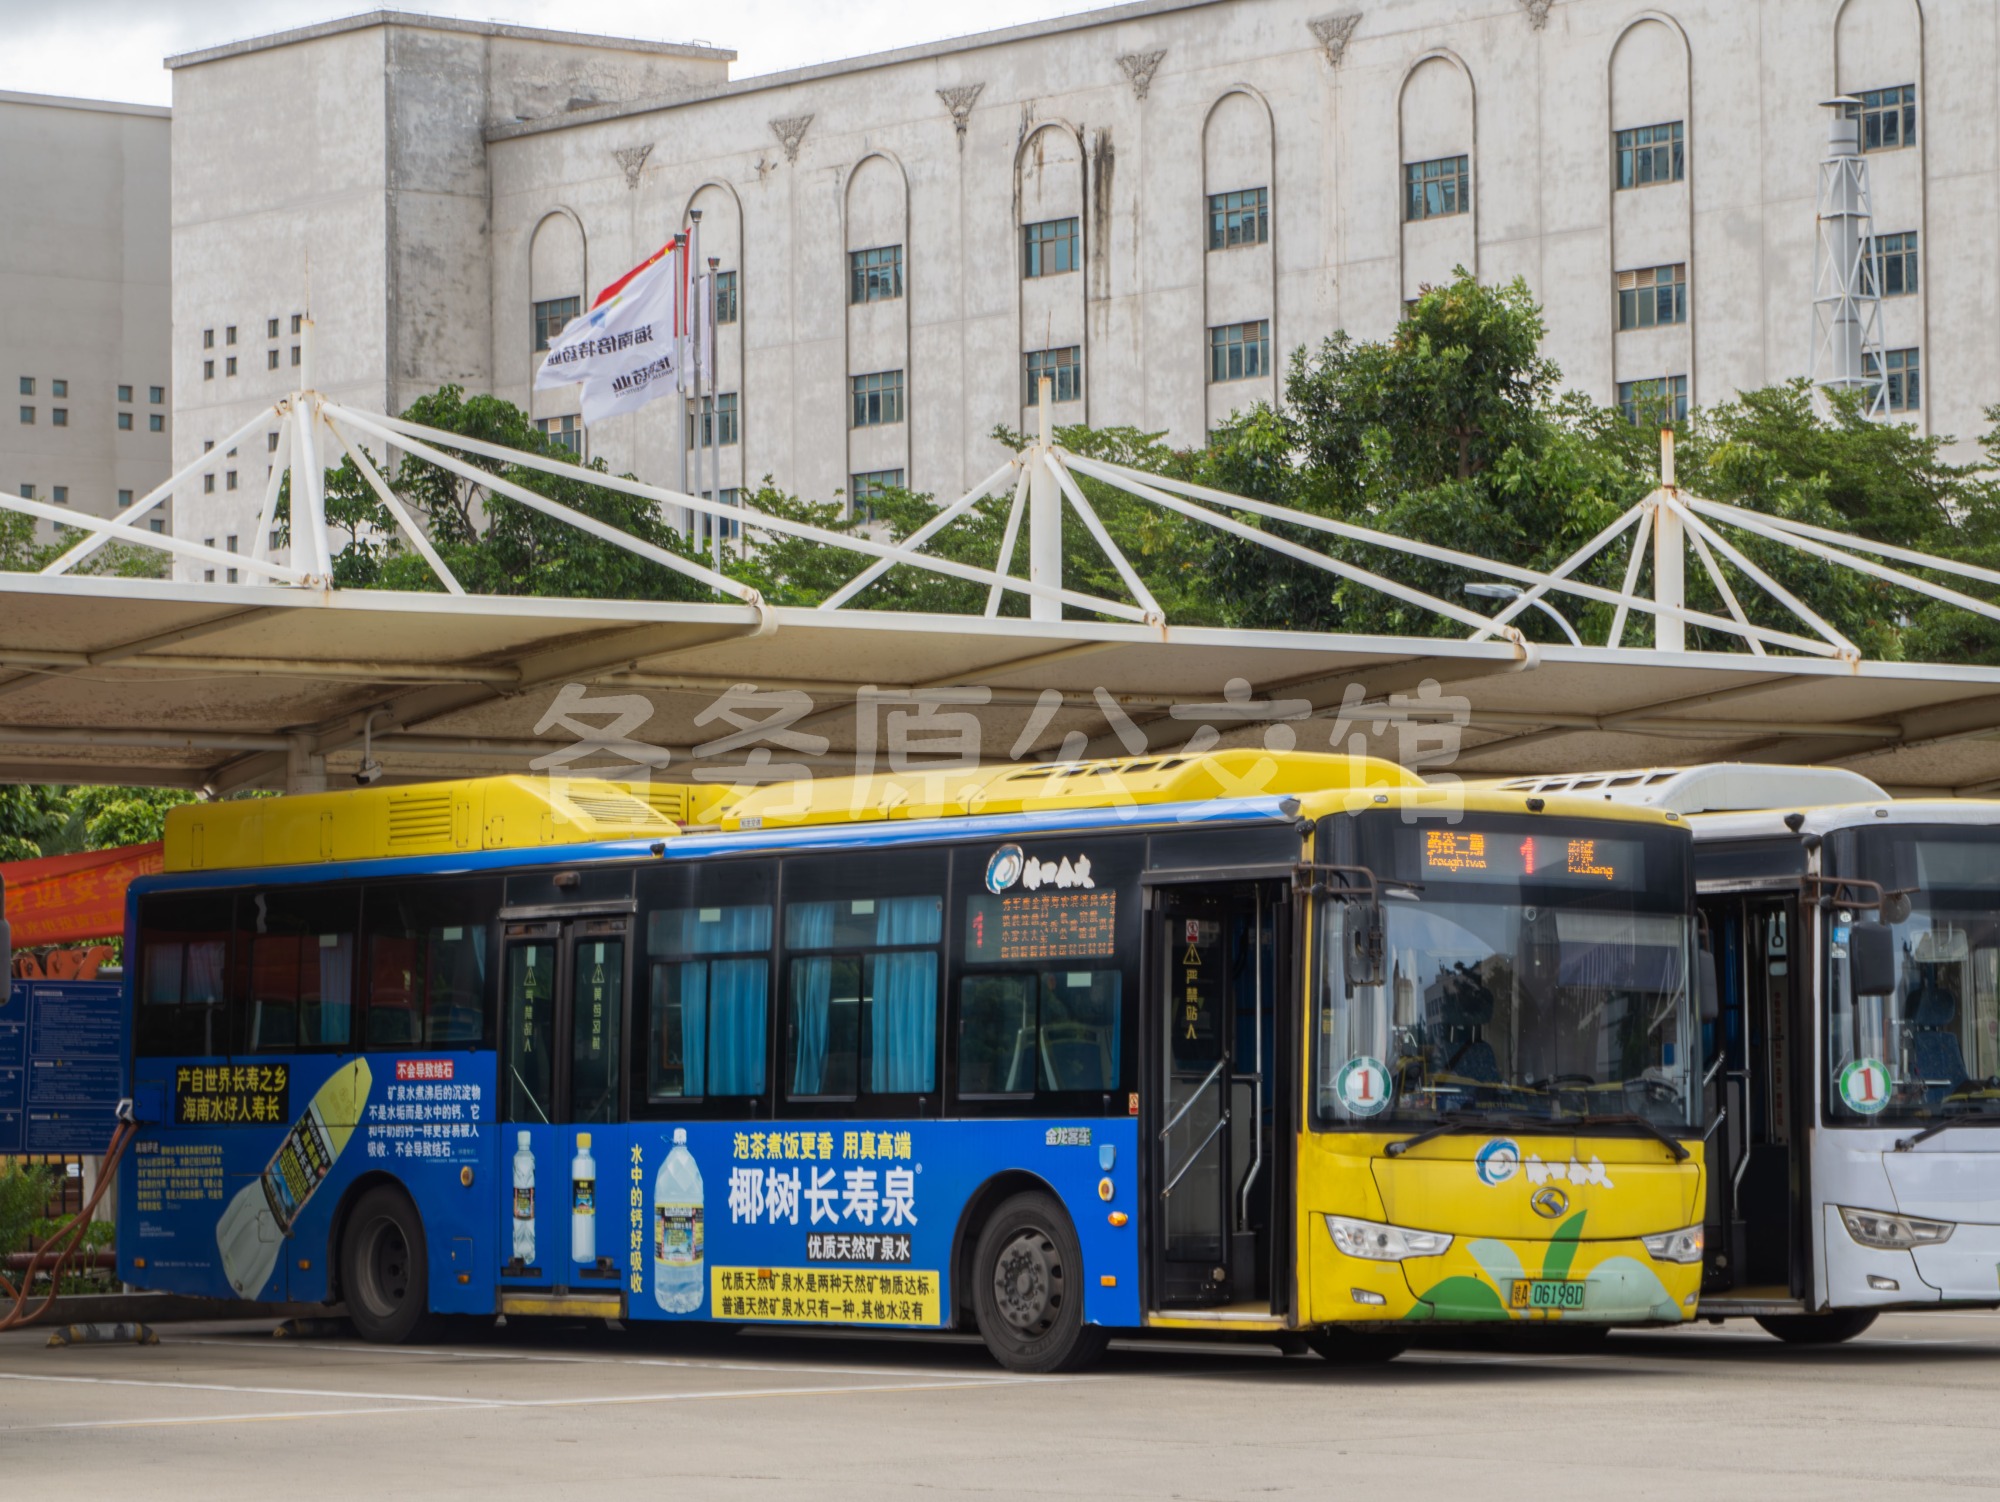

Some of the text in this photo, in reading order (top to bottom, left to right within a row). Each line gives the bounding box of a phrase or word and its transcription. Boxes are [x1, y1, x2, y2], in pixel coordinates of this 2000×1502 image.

[1520, 836, 1534, 875] 1
[972, 911, 984, 948] 1
[1185, 968, 1198, 1040] 严禁站人
[176, 1066, 287, 1094] 产自世界长寿之乡
[397, 1061, 453, 1080] 不会导致结石
[1357, 1068, 1374, 1101] 1
[1858, 1067, 1879, 1102] 1
[387, 1084, 481, 1102] 矿泉水煮沸后的沉淀物
[182, 1095, 280, 1123] 海南水好人寿长
[733, 1130, 912, 1160] 泡茶煮饭更香 用真高端
[1045, 1126, 1091, 1146] 金龙客车
[727, 1165, 919, 1226] 椰树长寿泉
[630, 1143, 643, 1295] 水中的钙好吸收
[807, 1234, 911, 1261] 优质天然矿泉水
[1534, 1284, 1584, 1305] 06198D
